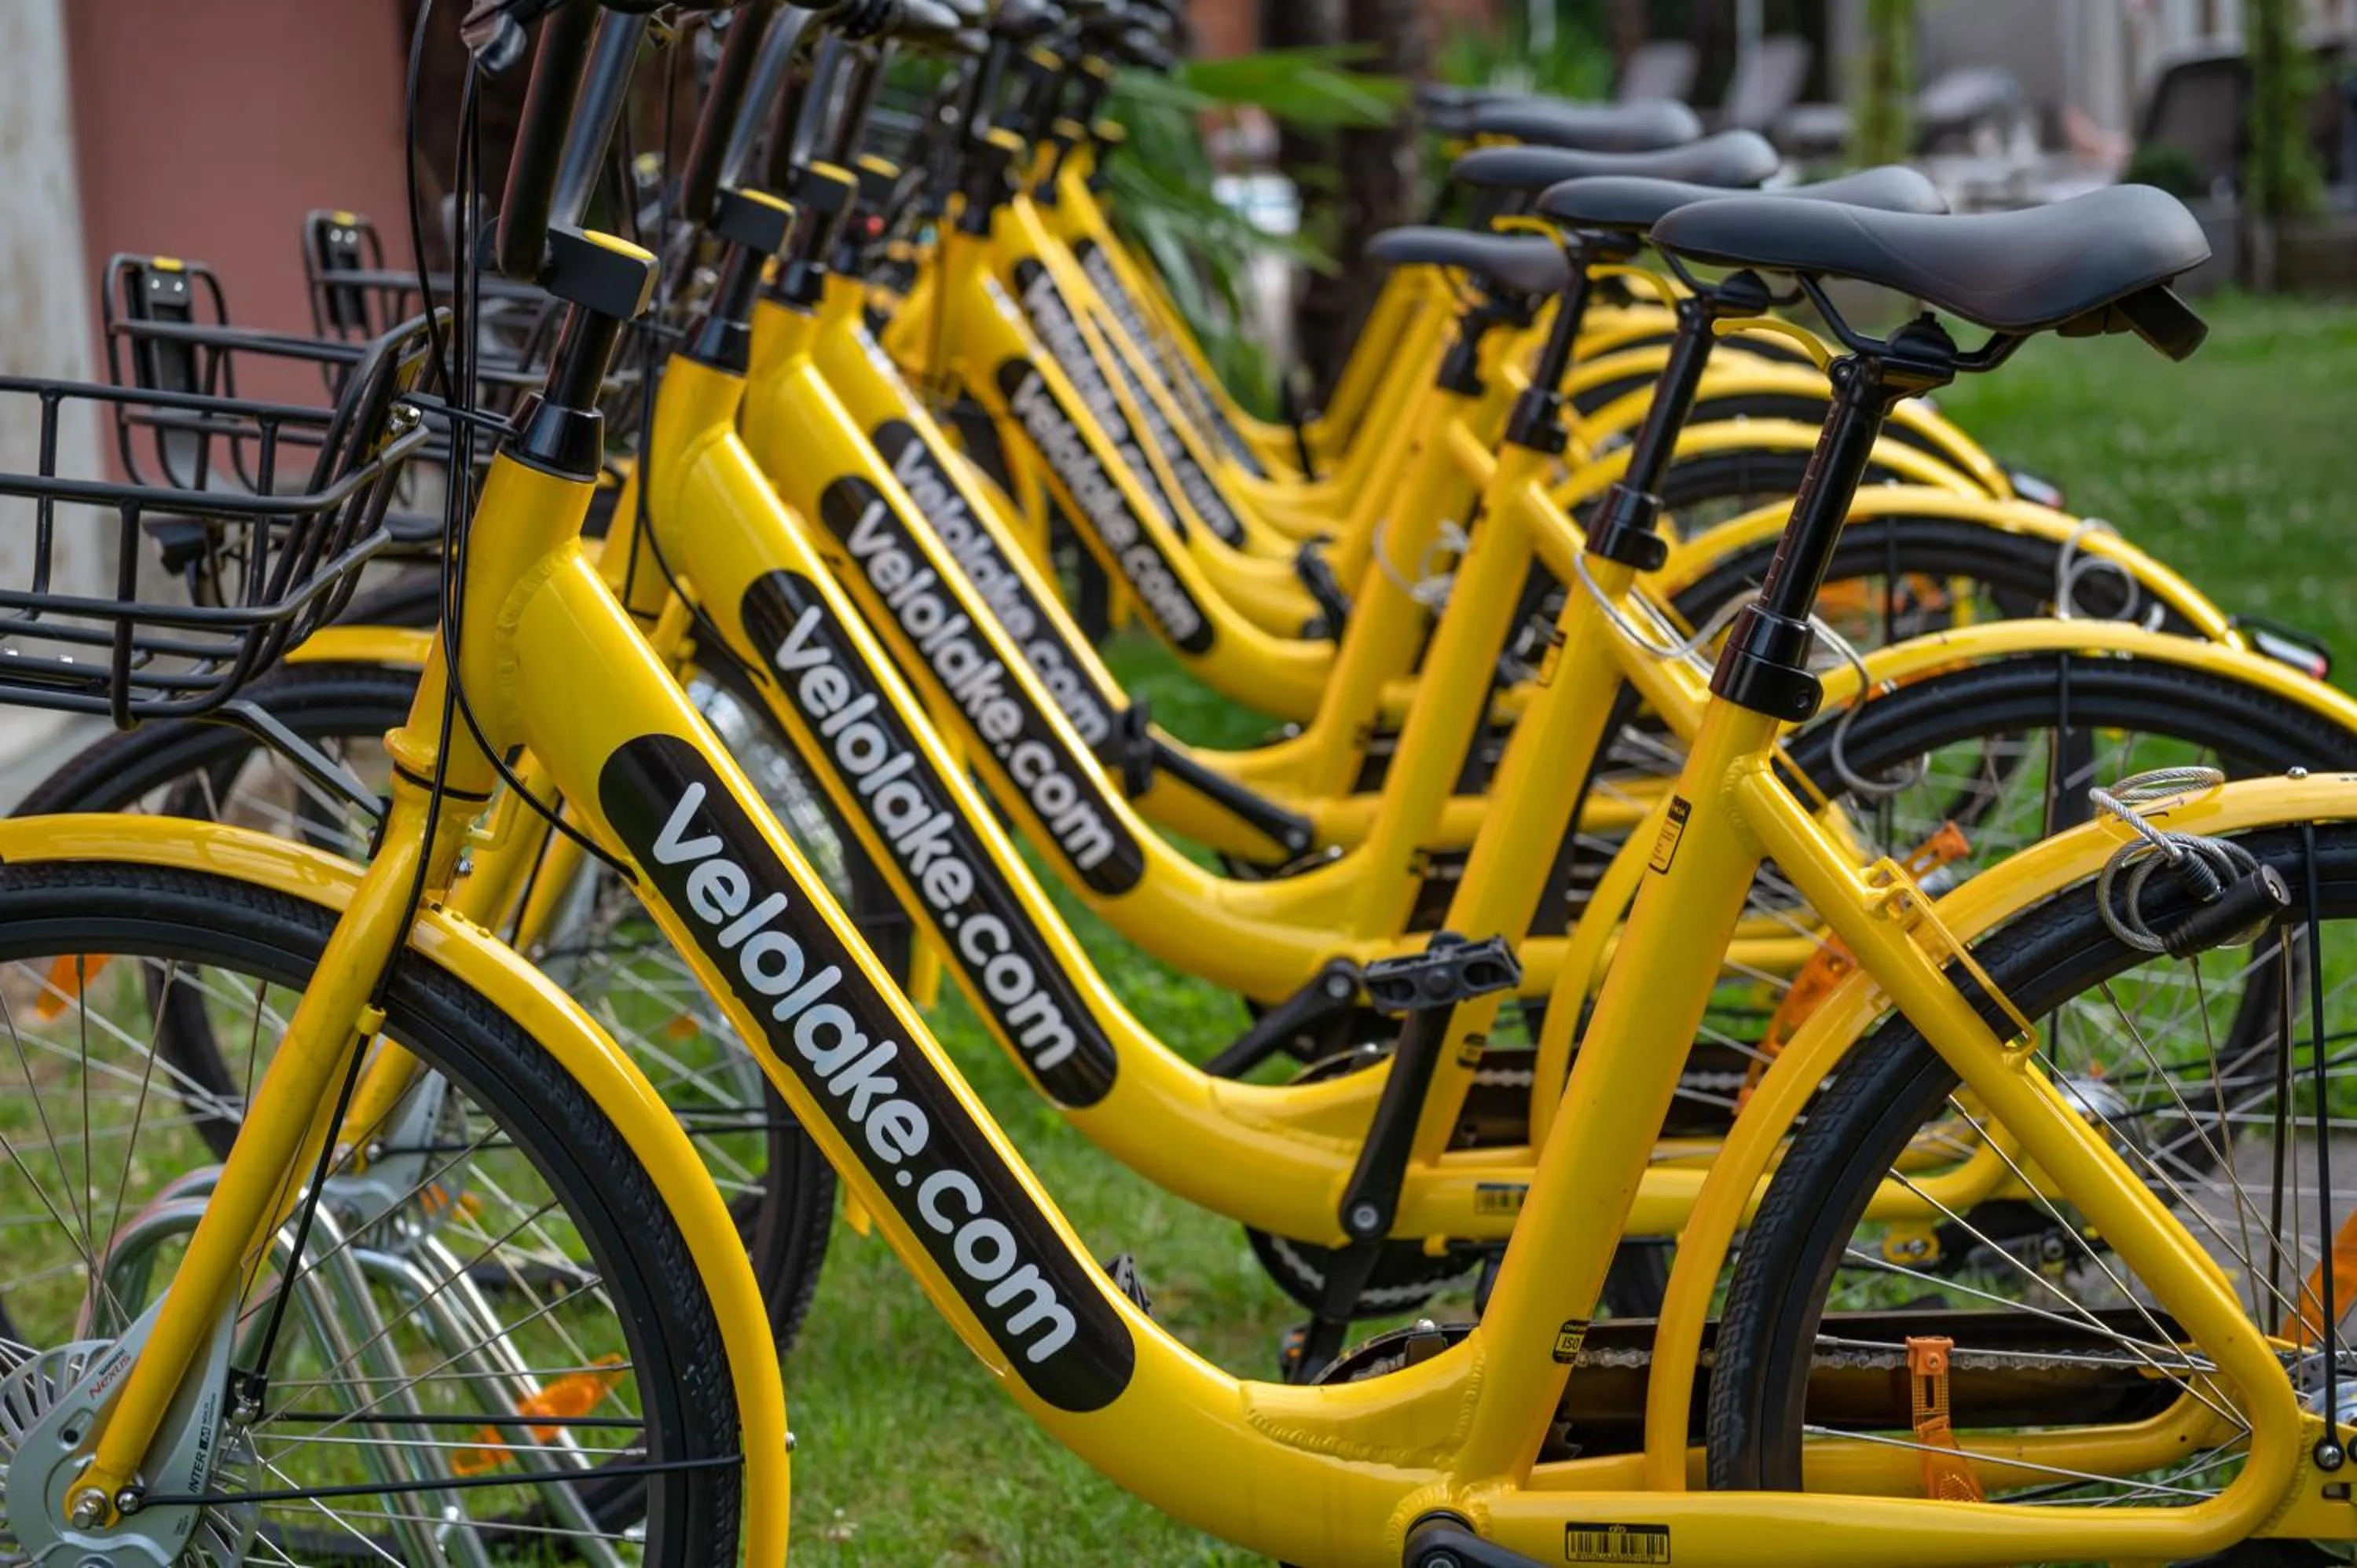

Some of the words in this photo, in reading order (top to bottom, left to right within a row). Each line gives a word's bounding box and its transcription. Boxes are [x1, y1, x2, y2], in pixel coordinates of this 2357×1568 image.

[893, 438, 1110, 746] Velolakecom
[1011, 369, 1201, 640] Velolakecom
[775, 604, 1076, 1071] Velolake.com
[847, 500, 1115, 870] Velolake.com
[652, 781, 1076, 1364] Velolake.com
[188, 1452, 207, 1493] INTER
